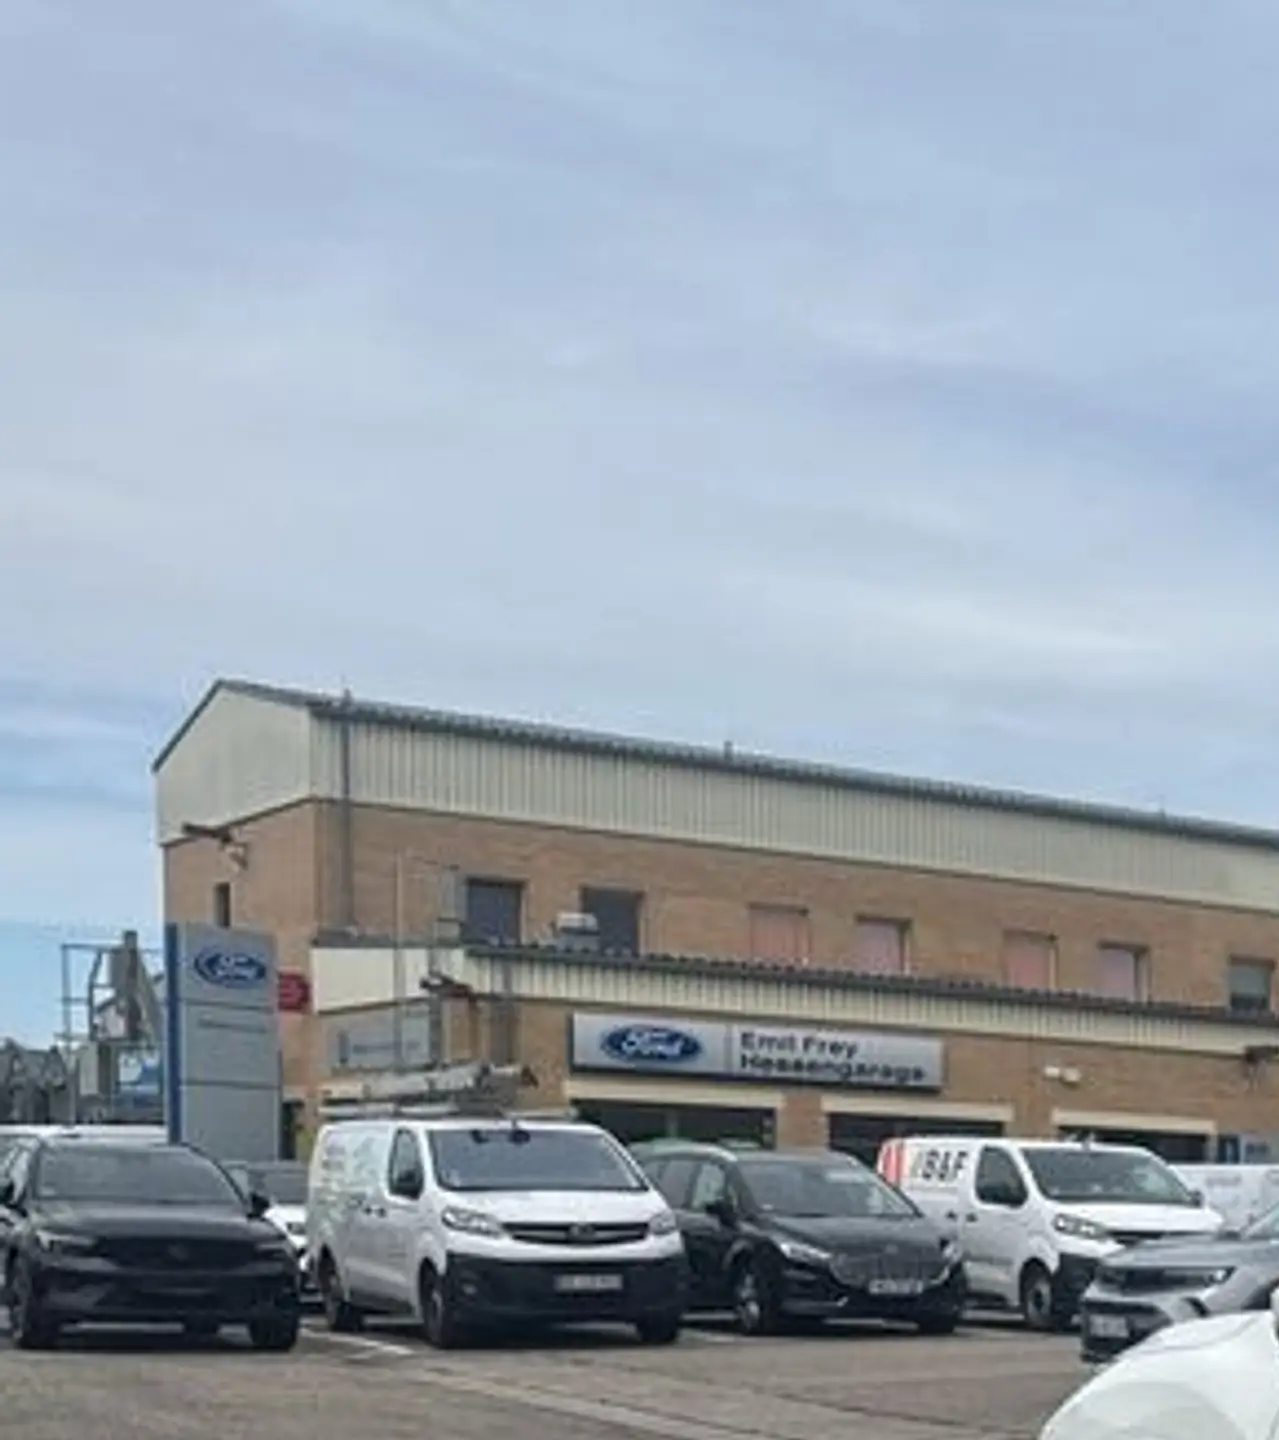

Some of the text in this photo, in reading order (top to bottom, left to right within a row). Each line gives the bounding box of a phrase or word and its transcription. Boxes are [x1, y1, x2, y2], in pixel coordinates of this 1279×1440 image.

[615, 1028, 687, 1059] Ford
[740, 1031, 858, 1060] Emil Frey
[740, 1053, 926, 1083] Hessengarage
